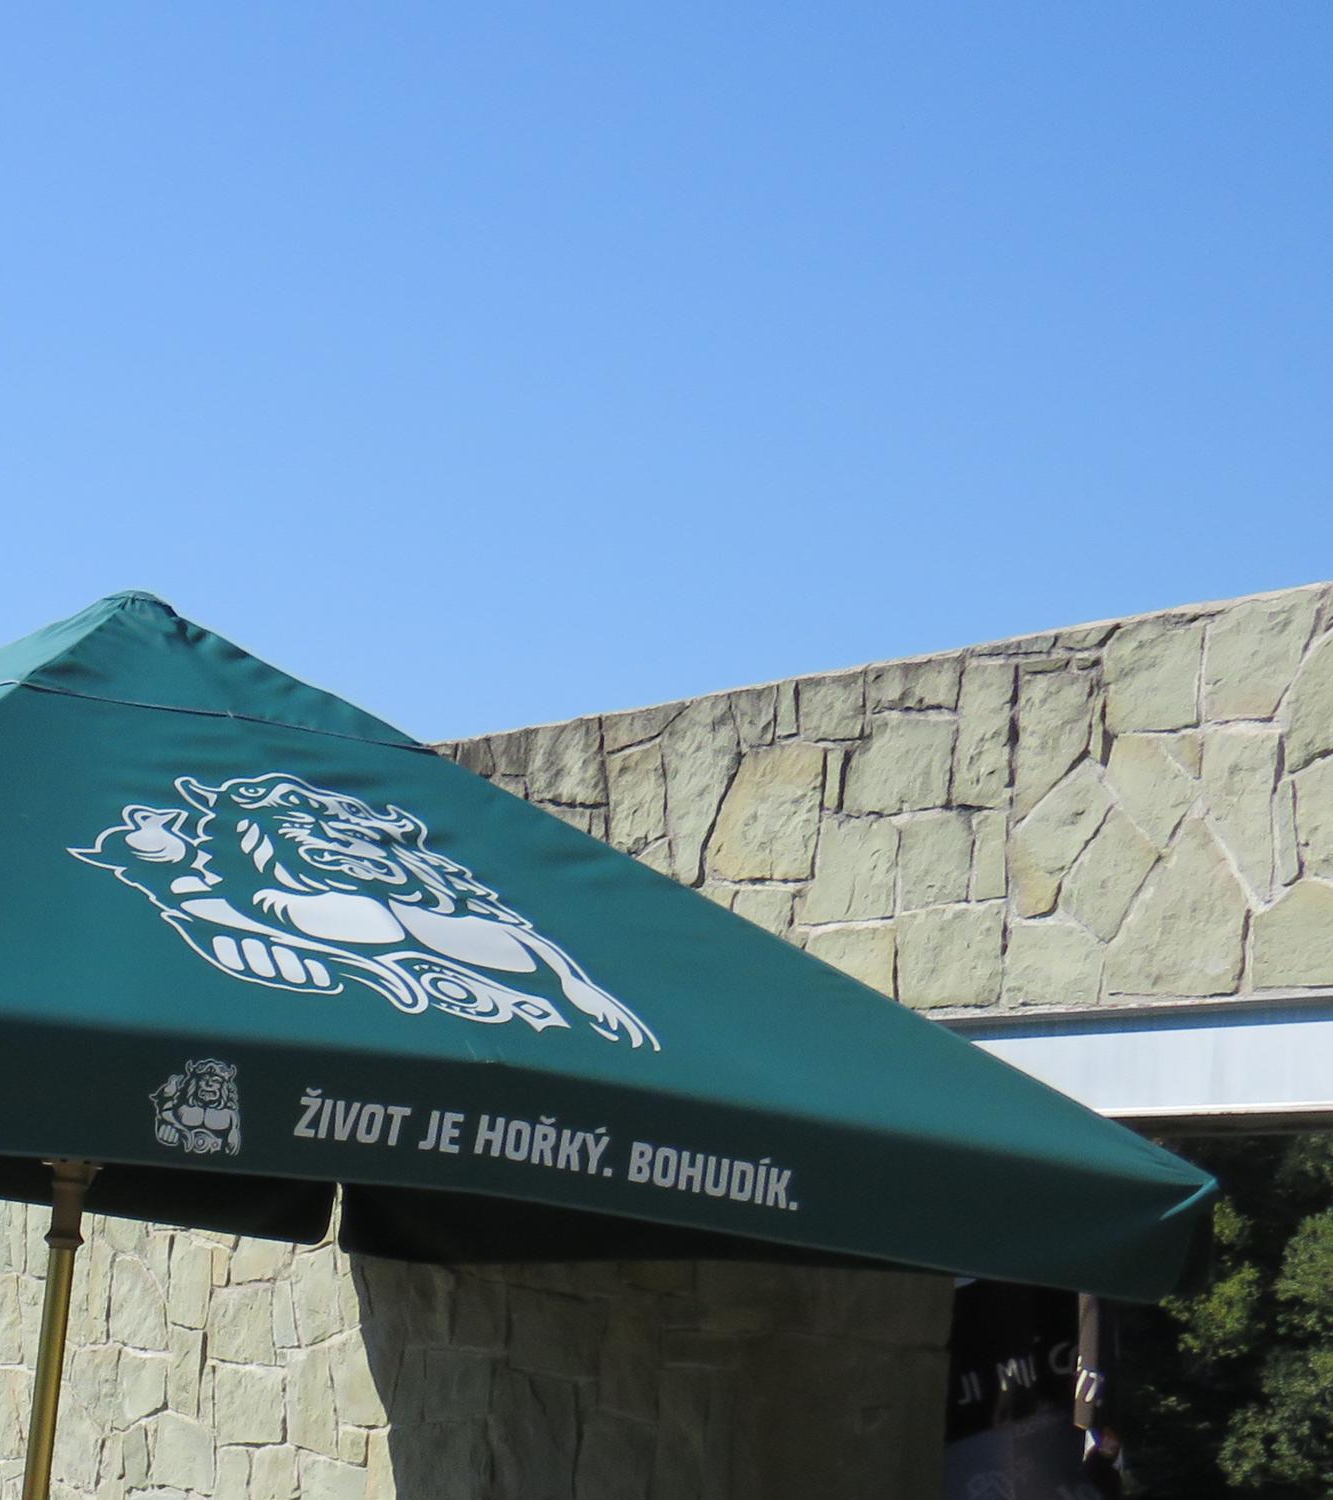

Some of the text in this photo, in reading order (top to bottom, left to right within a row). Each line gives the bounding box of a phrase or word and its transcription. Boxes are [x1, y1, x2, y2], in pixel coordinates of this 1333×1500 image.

[292, 1088, 799, 1211] ŽIVOT JE HOŘKÝ. BOHUDÍK.
